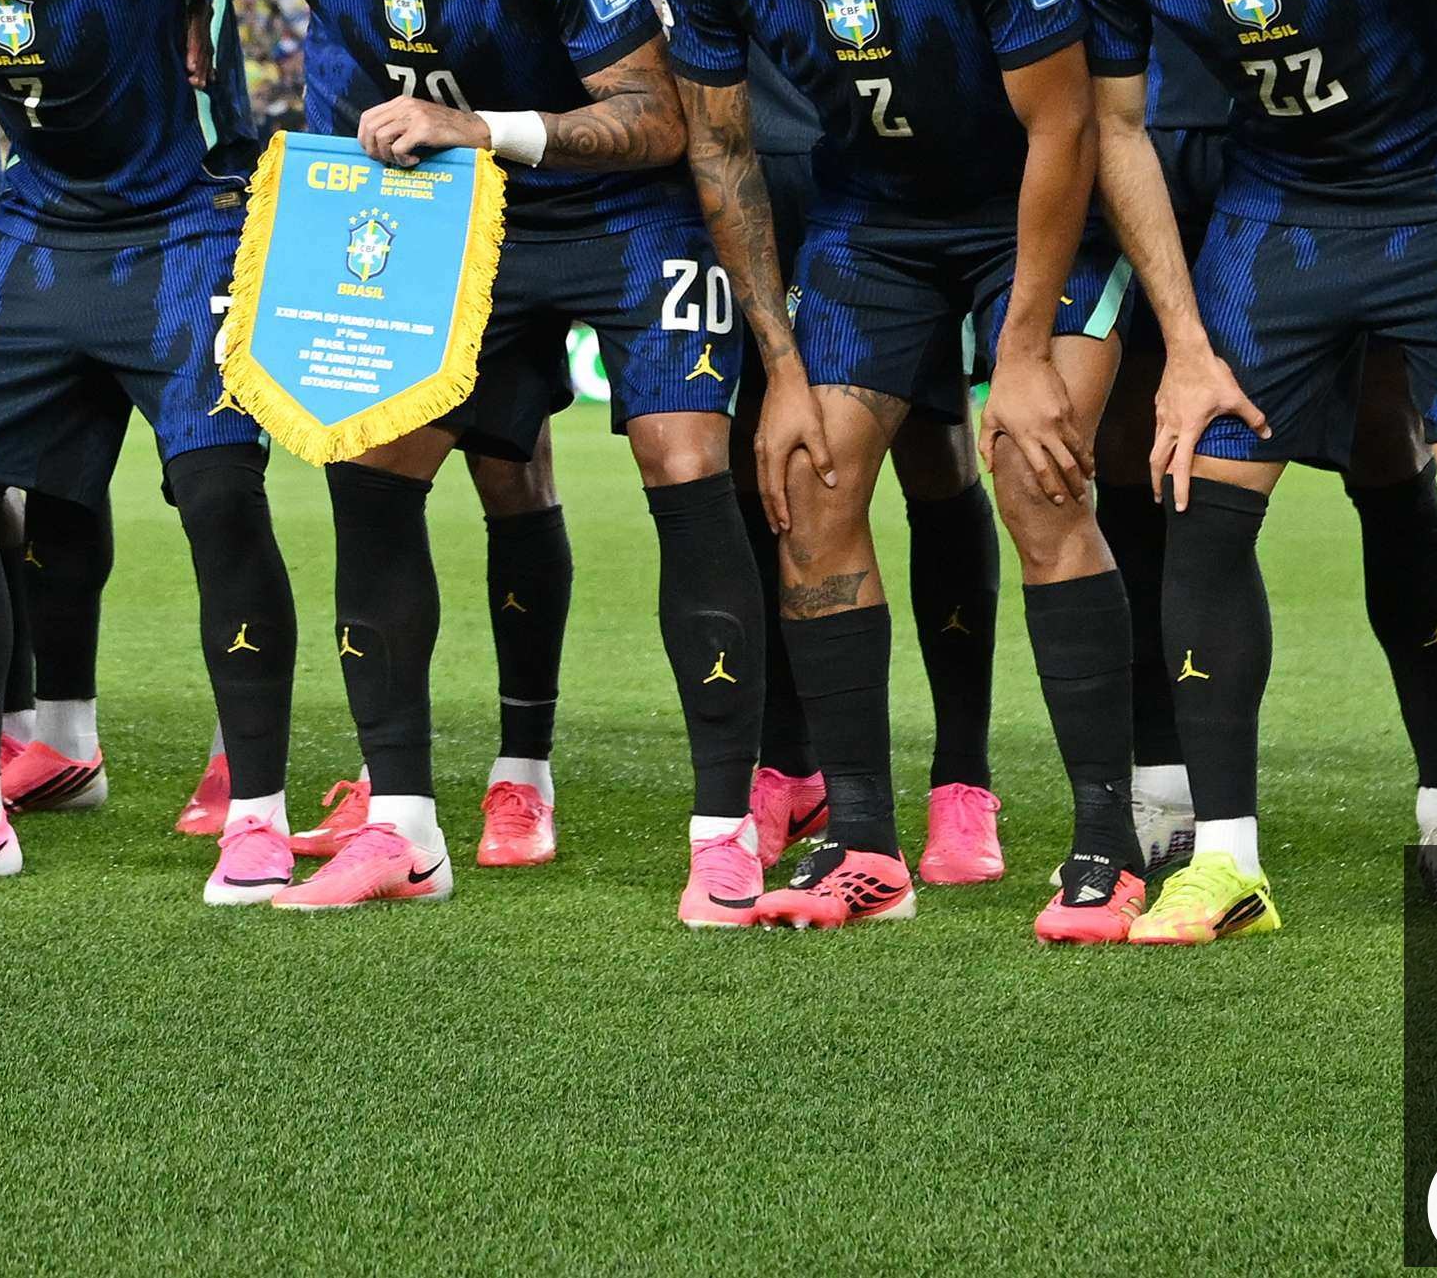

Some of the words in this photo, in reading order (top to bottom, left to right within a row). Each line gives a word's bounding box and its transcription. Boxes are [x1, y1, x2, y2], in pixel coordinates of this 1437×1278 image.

[840, 5, 861, 17] CBF
[1237, 23, 1298, 45] BRASIL
[388, 37, 438, 54] BRASIL
[835, 46, 892, 62] BRASIL
[1240, 47, 1348, 117] 22
[7, 76, 43, 128] 7
[855, 77, 914, 137] 2
[307, 161, 371, 192] CBF
[336, 282, 385, 300] BRASIL
[661, 259, 733, 335] 20
[312, 337, 347, 352] BRASIL
[358, 343, 386, 356] HAITI
[308, 363, 377, 381] PHILADELPHIA
[300, 375, 344, 390] ESTADOS
[344, 379, 380, 394] UNIDOS
